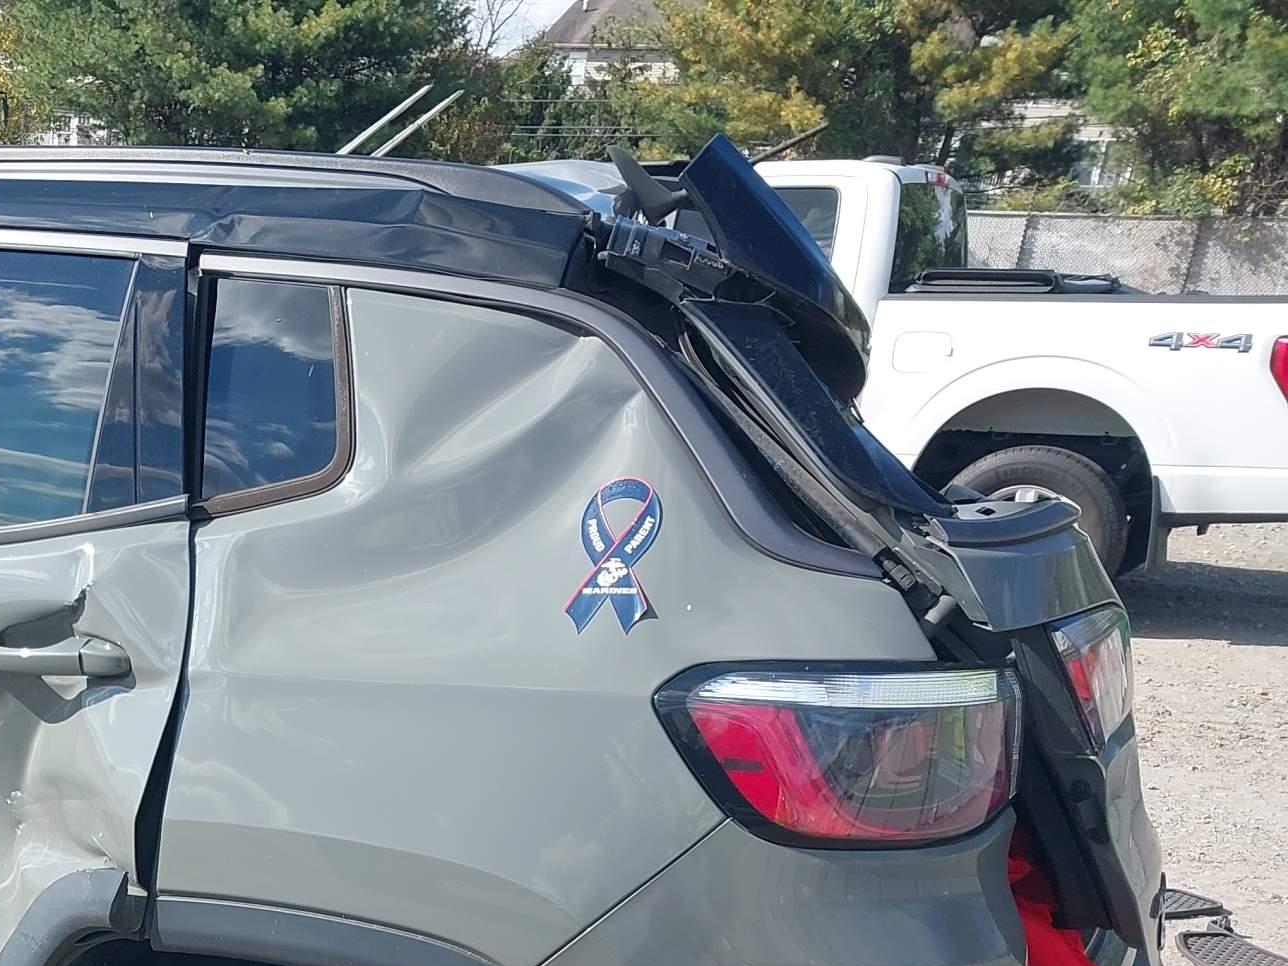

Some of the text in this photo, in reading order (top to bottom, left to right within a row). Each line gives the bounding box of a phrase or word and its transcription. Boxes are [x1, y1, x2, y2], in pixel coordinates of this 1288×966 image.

[587, 517, 606, 553] PROUD
[623, 515, 656, 554] PARENT
[581, 587, 638, 595] MARINES
